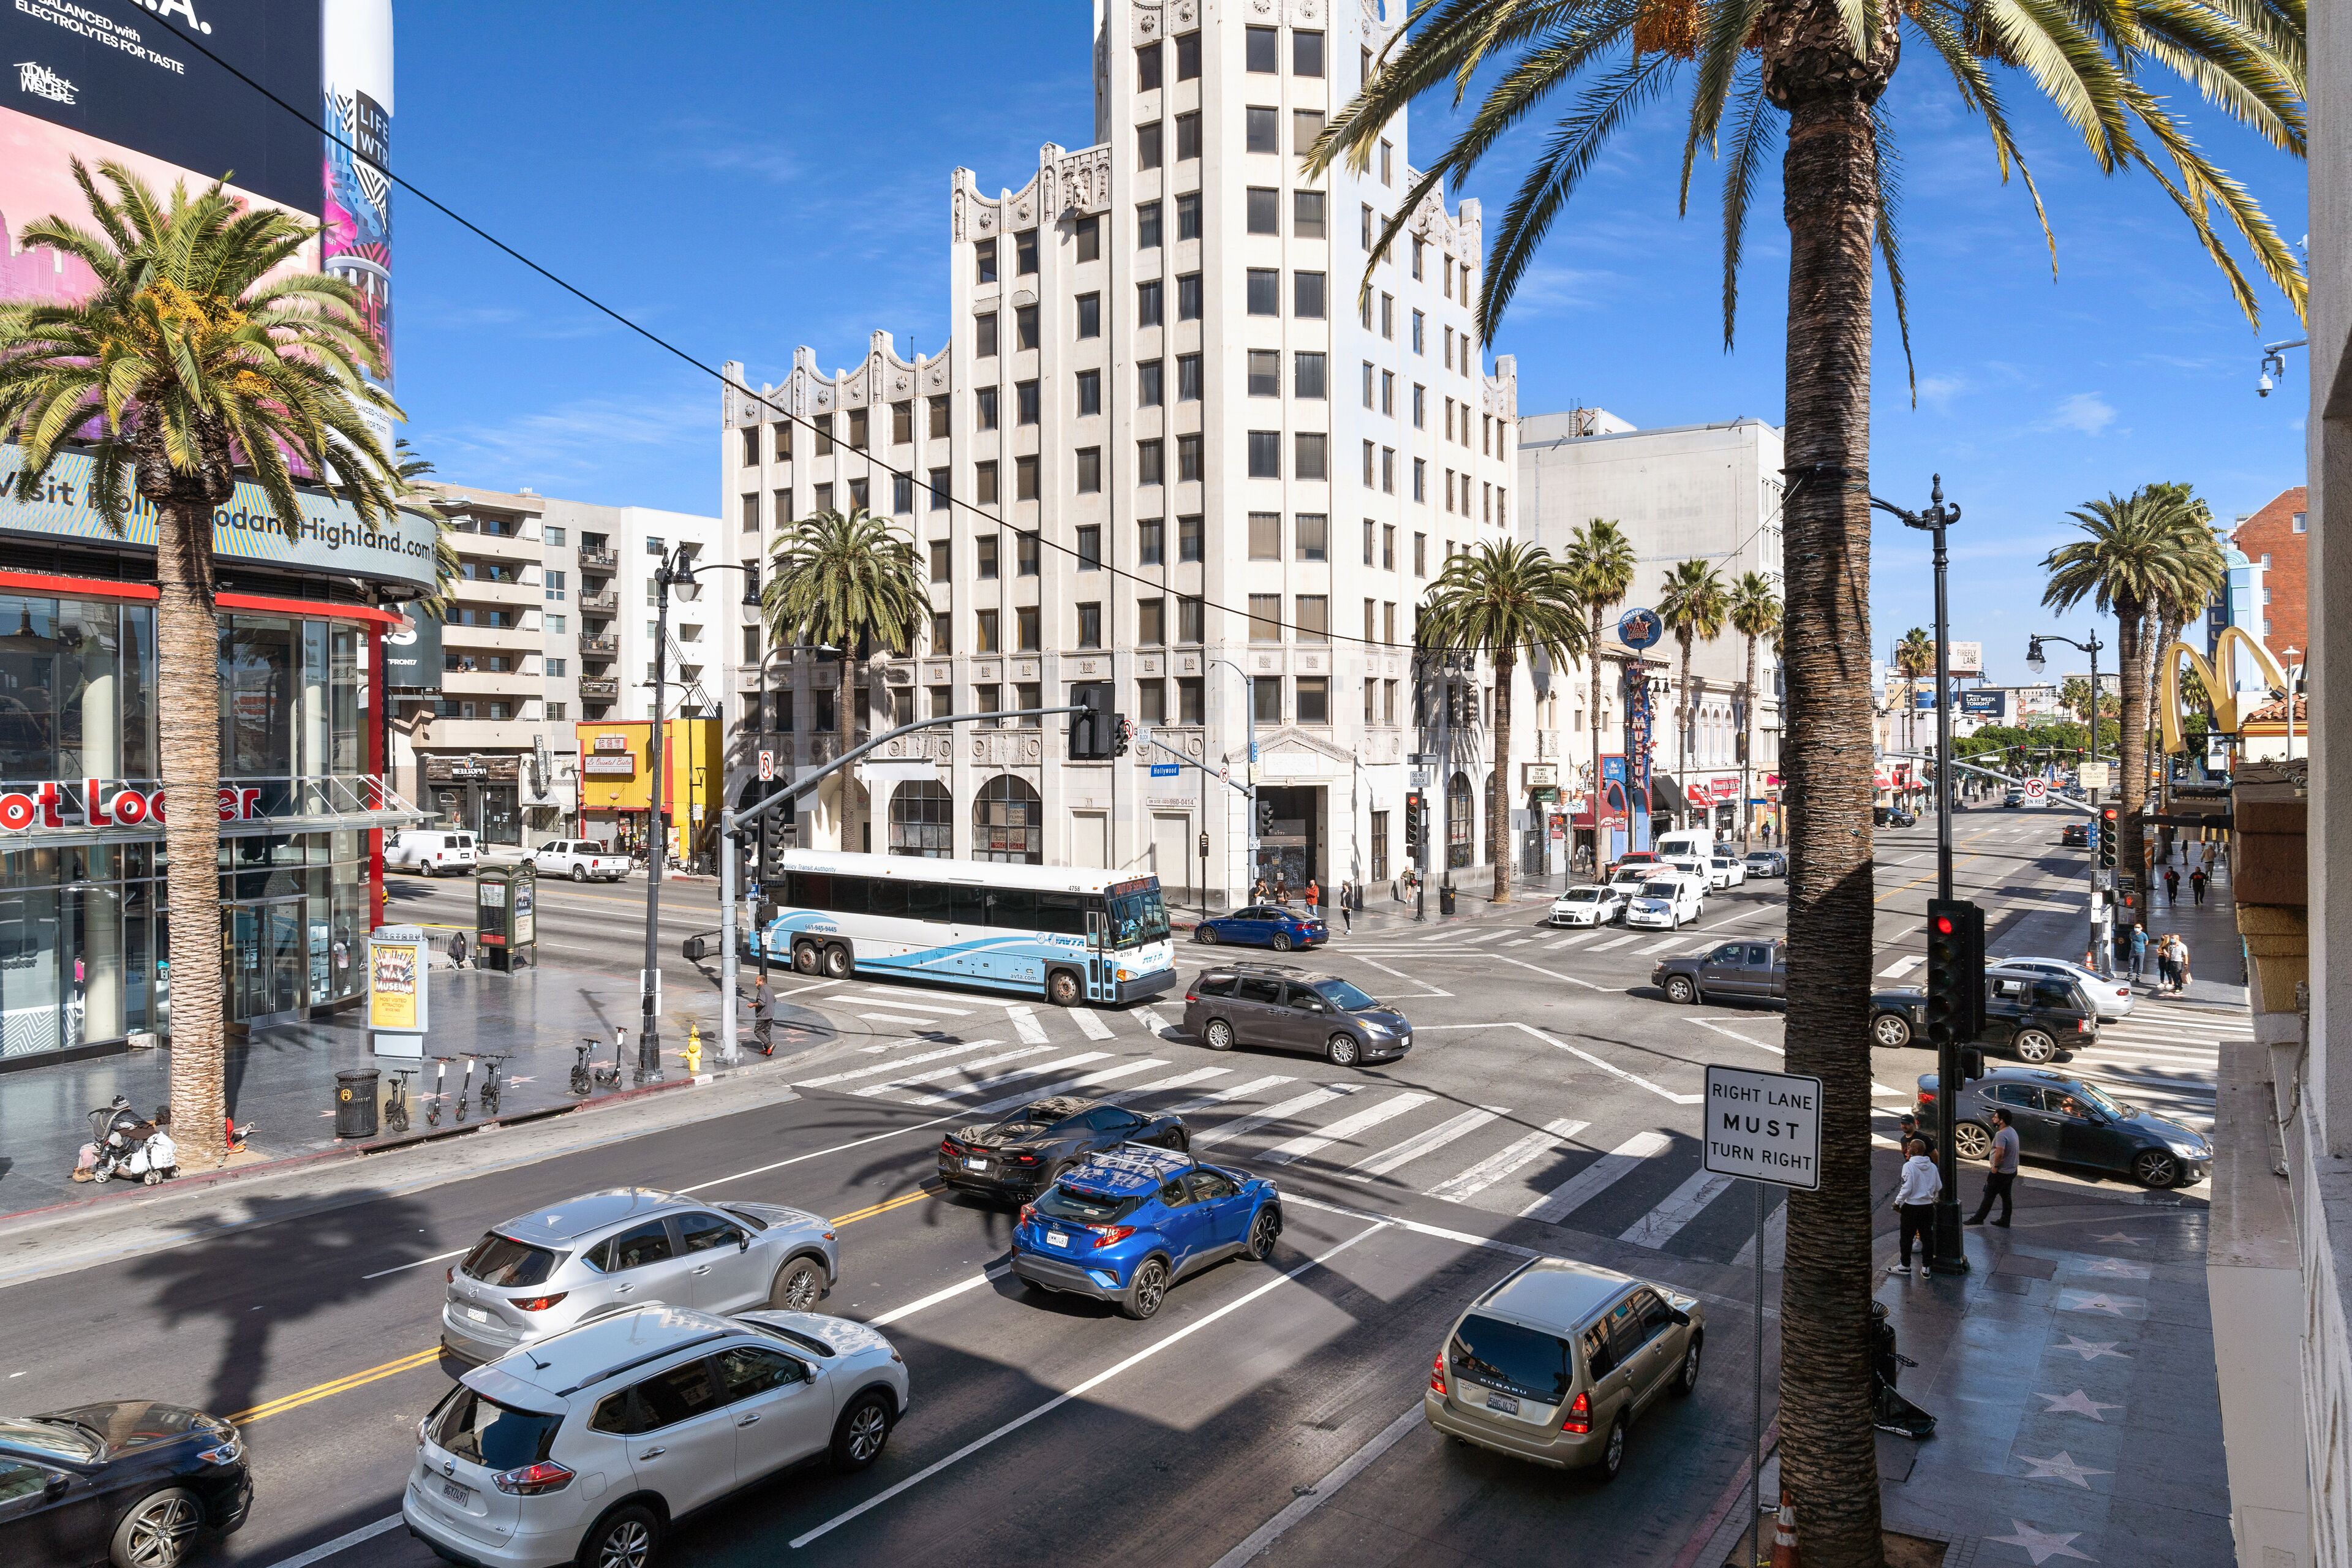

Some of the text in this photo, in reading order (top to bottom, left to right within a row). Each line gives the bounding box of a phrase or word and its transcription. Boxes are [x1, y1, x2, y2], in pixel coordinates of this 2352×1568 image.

[15, 0, 184, 75] ELECTROLYTES FOR TASTE
[114, 26, 140, 42] with
[360, 104, 388, 143] LIFE
[360, 130, 388, 169] WTR
[367, 420, 387, 434] FOR TASTE
[0, 471, 75, 507] Vsit
[1624, 621, 1648, 633] WAX
[1632, 716, 1646, 789] MUSEUM
[83, 777, 262, 827] Locer
[1116, 883, 1126, 895] OUT
[1126, 882, 1133, 892] OF
[805, 924, 837, 932] 661-945-9445
[1142, 952, 1163, 964] AVTA
[1713, 1083, 1812, 1110] RIGHT LANE
[1724, 1112, 1800, 1139] MUST
[1710, 1141, 1812, 1170] TURN RIGHT
[1480, 1378, 1527, 1395] SUBARU
[443, 1484, 467, 1502] 8GYZ497
